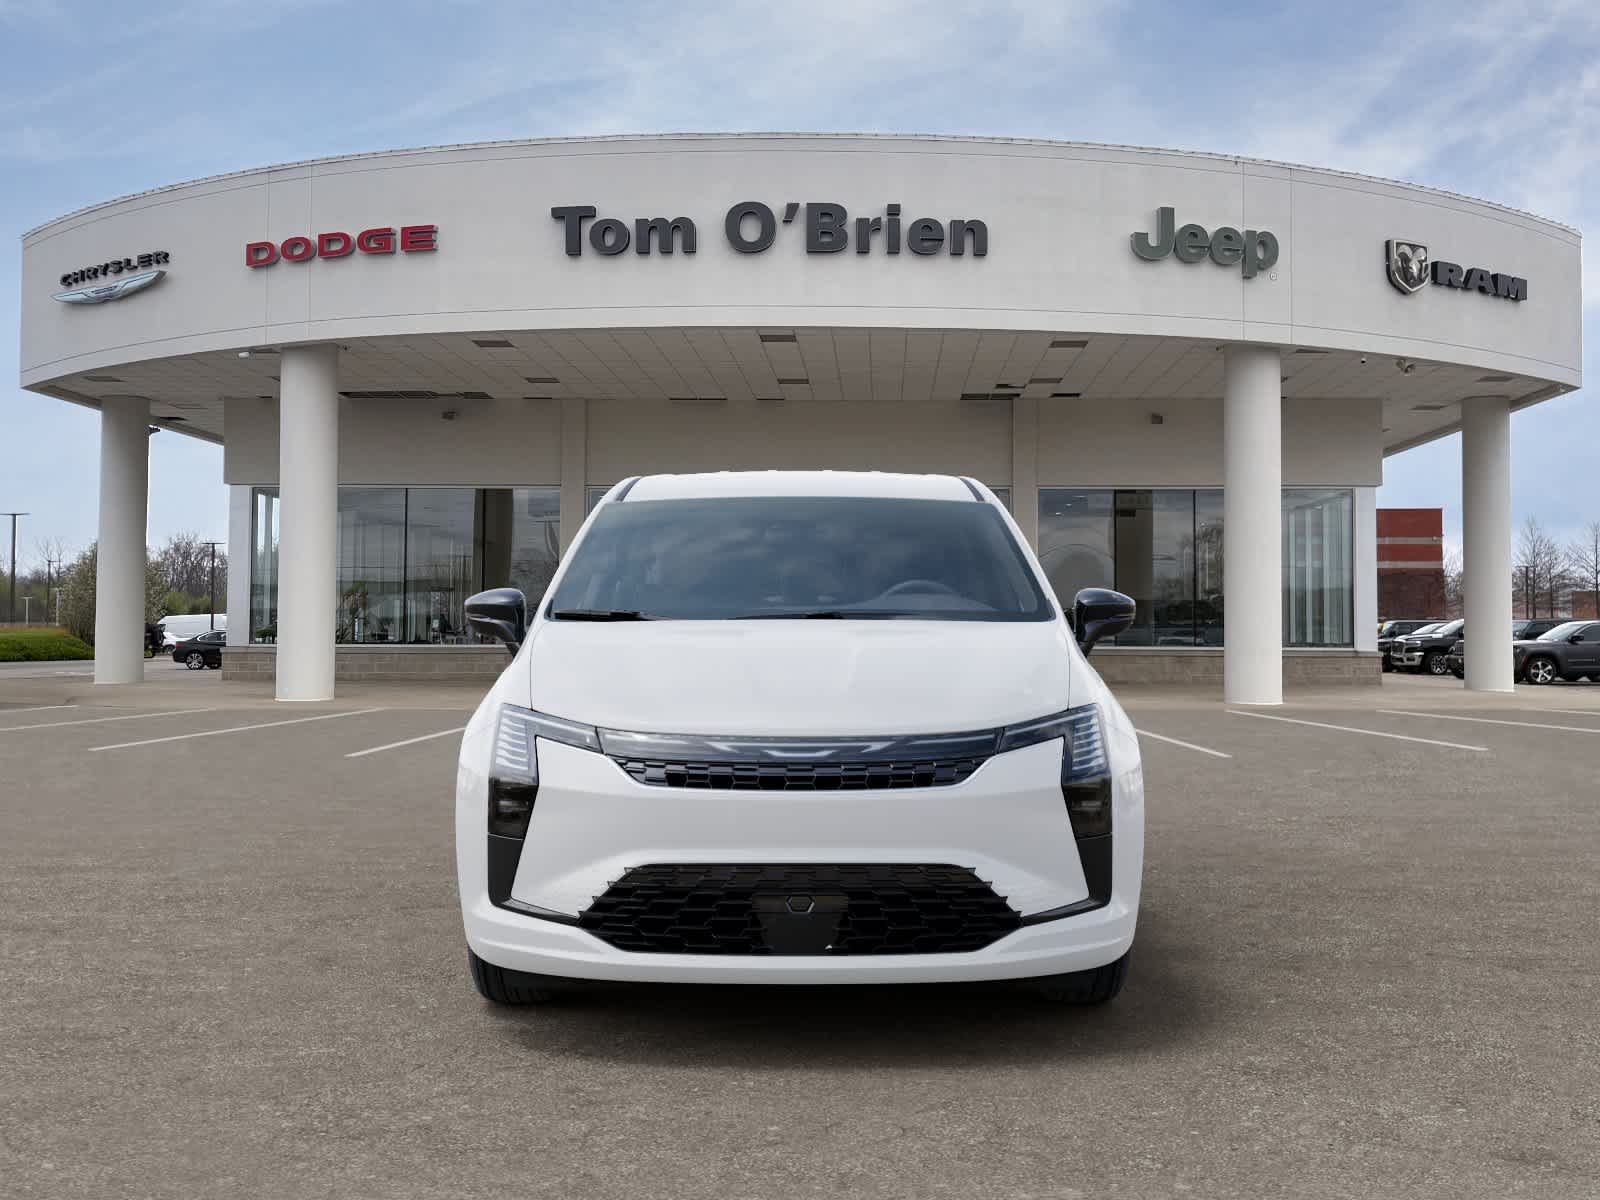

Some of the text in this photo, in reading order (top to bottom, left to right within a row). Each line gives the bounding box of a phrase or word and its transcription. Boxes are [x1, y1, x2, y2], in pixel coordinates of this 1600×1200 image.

[245, 225, 437, 269] DODGE
[551, 201, 988, 256] Tom O’Brien
[1130, 207, 1279, 279] Jeep
[60, 250, 170, 287] CHRYSLER
[1431, 260, 1527, 302] RAM
